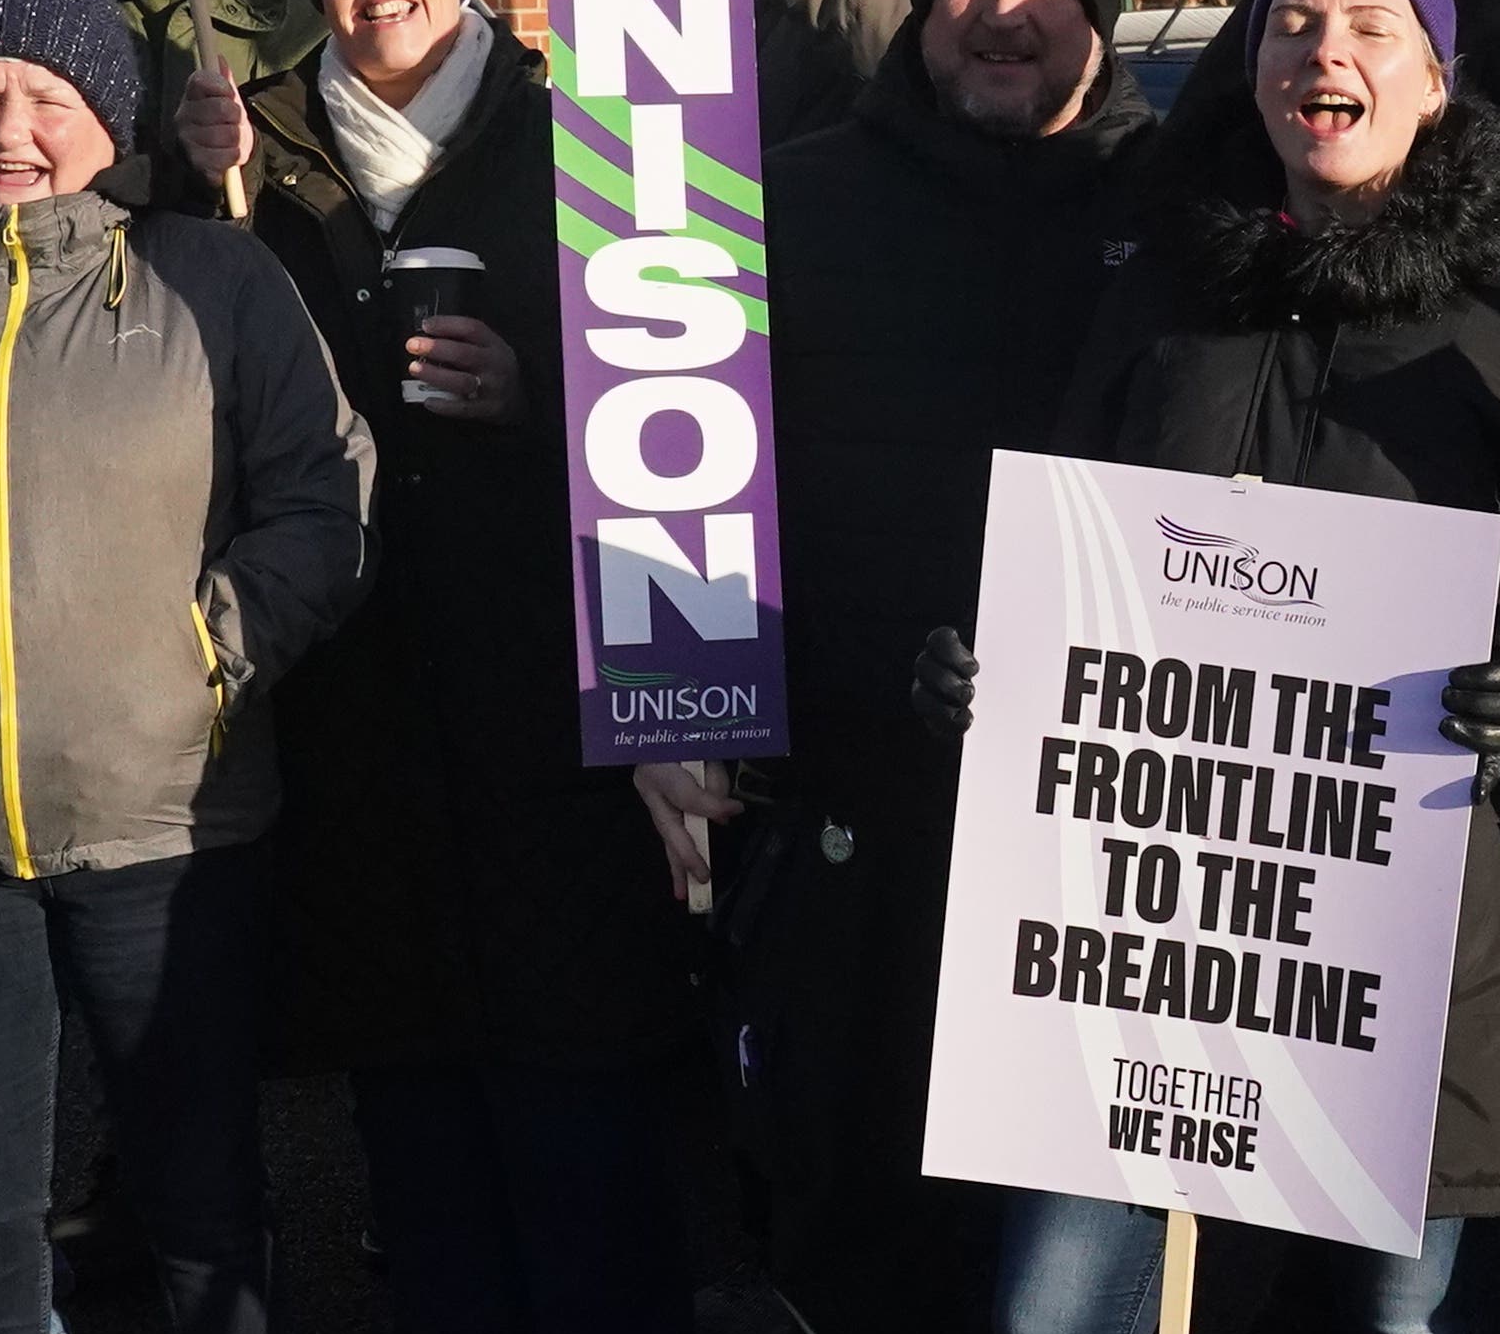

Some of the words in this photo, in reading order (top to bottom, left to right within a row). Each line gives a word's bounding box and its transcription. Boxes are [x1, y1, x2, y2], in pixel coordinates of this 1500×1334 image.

[1164, 547, 1319, 601] UNISON
[1160, 592, 1182, 610] the
[1185, 595, 1229, 619] public
[1231, 602, 1281, 622] service
[1285, 608, 1326, 628] union
[612, 685, 756, 723] UNISON
[615, 731, 634, 746] the
[638, 729, 678, 748] public
[731, 725, 771, 739] union
[1061, 645, 1256, 749] FROM
[1270, 676, 1392, 769] THE
[1035, 736, 1397, 866] FRONTLINE
[1101, 839, 1182, 923] TO
[1195, 852, 1317, 947] THE
[1011, 920, 1381, 1053] BREADLINE
[1112, 1058, 1263, 1122] TOGETHER
[1108, 1105, 1166, 1157] WE
[1169, 1111, 1258, 1173] RISE
